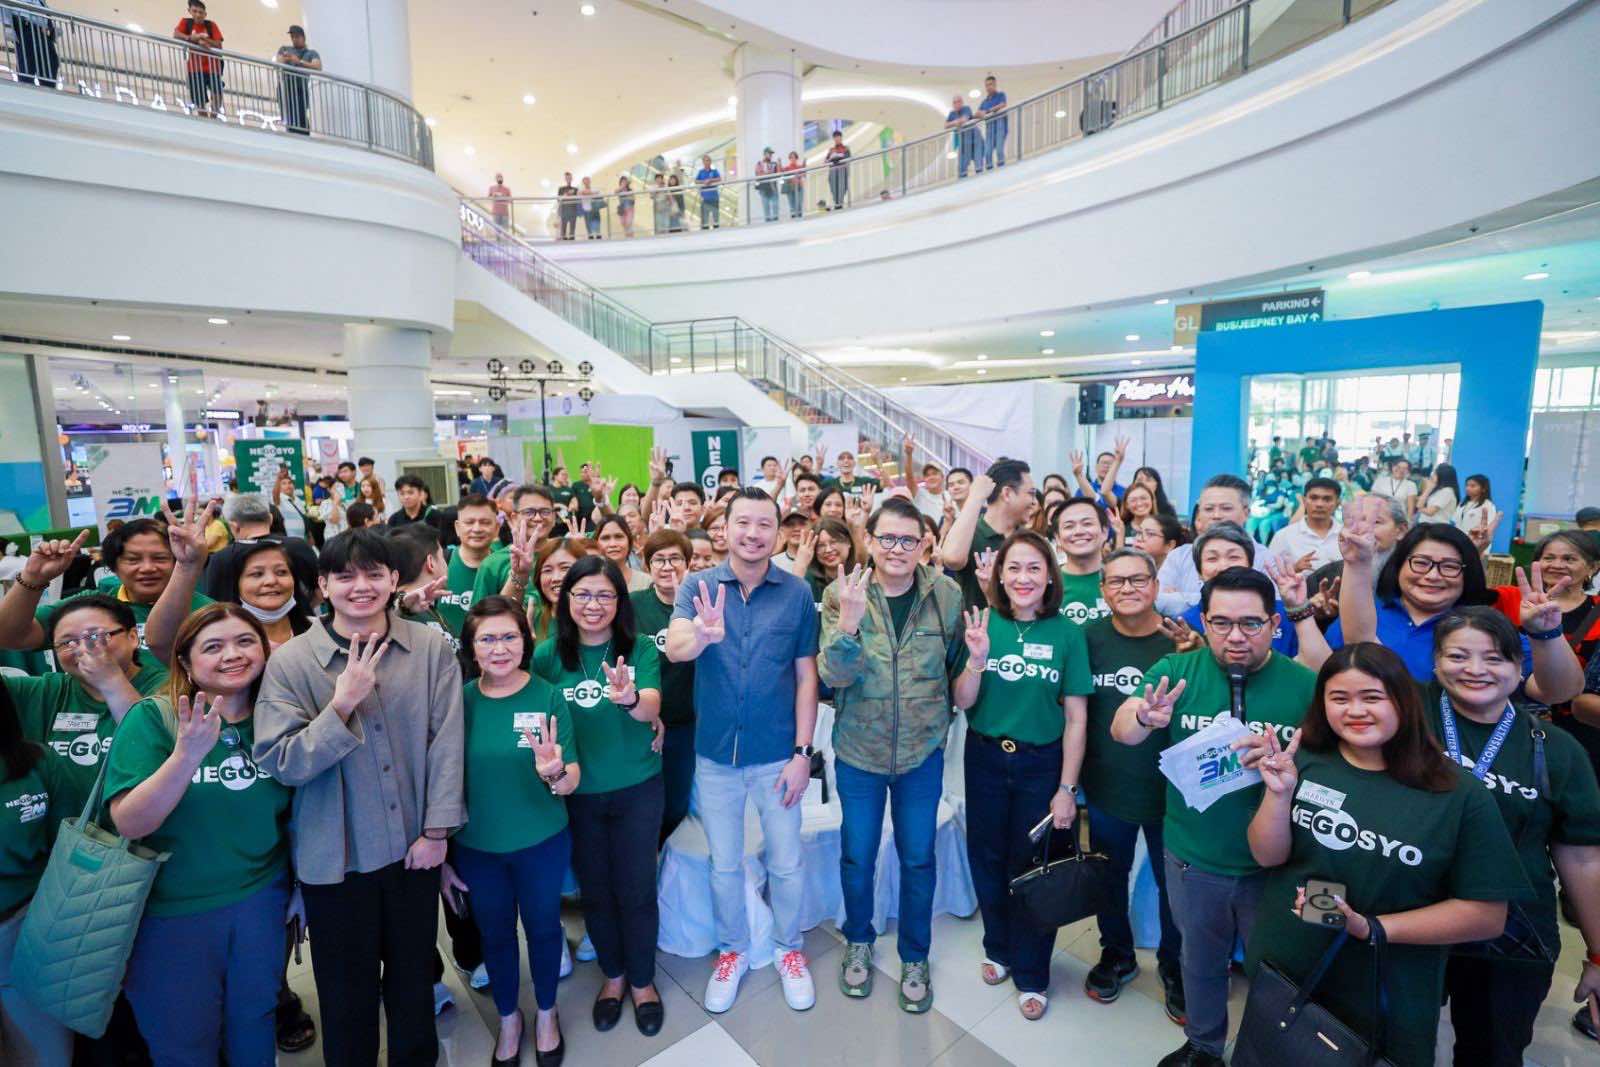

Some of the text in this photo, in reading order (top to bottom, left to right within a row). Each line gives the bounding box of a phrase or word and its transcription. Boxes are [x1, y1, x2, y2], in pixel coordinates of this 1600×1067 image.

[1262, 298, 1310, 313] PARKING
[1175, 315, 1199, 332] GL
[1286, 312, 1309, 325] BAY
[1481, 711, 1515, 764] CONSULTING
[1198, 751, 1243, 784] 3M
